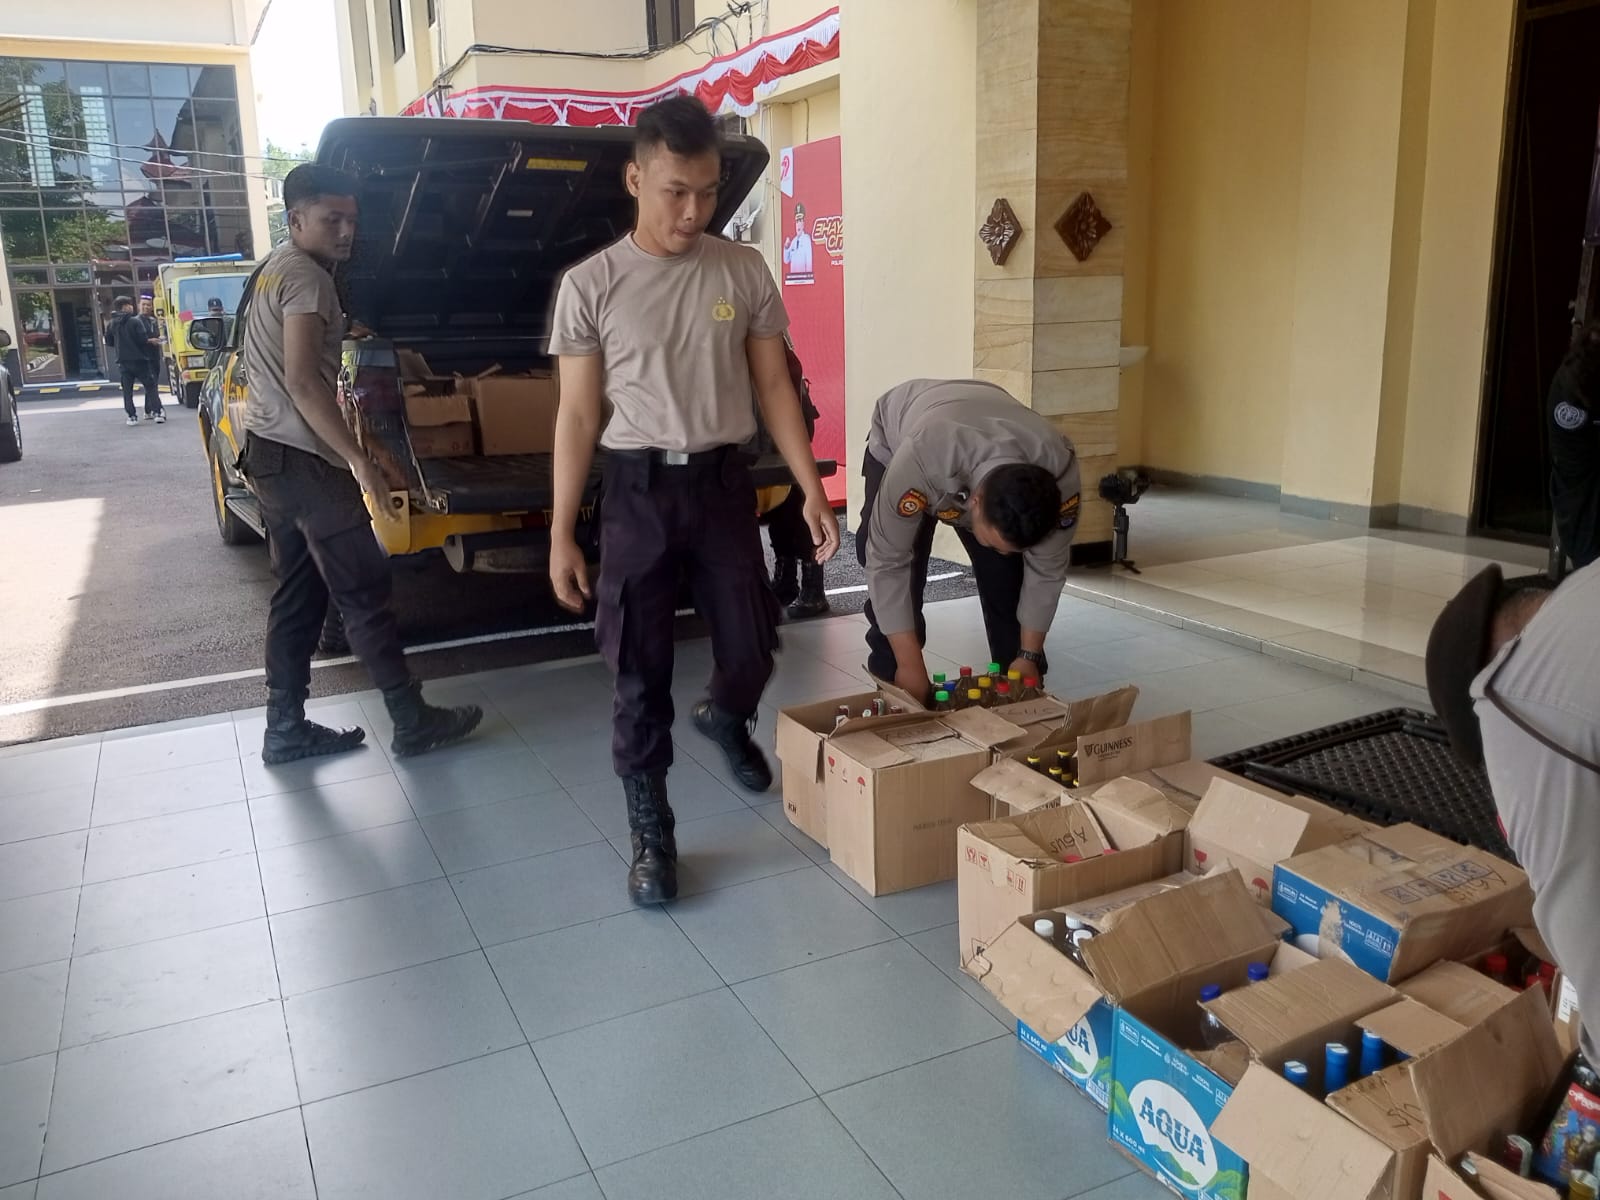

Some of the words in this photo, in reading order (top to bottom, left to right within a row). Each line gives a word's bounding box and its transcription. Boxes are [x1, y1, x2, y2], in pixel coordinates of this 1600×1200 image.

[1094, 737, 1133, 755] GUINNESS
[1066, 1023, 1091, 1056] UA
[1139, 1096, 1206, 1166] AQUA
